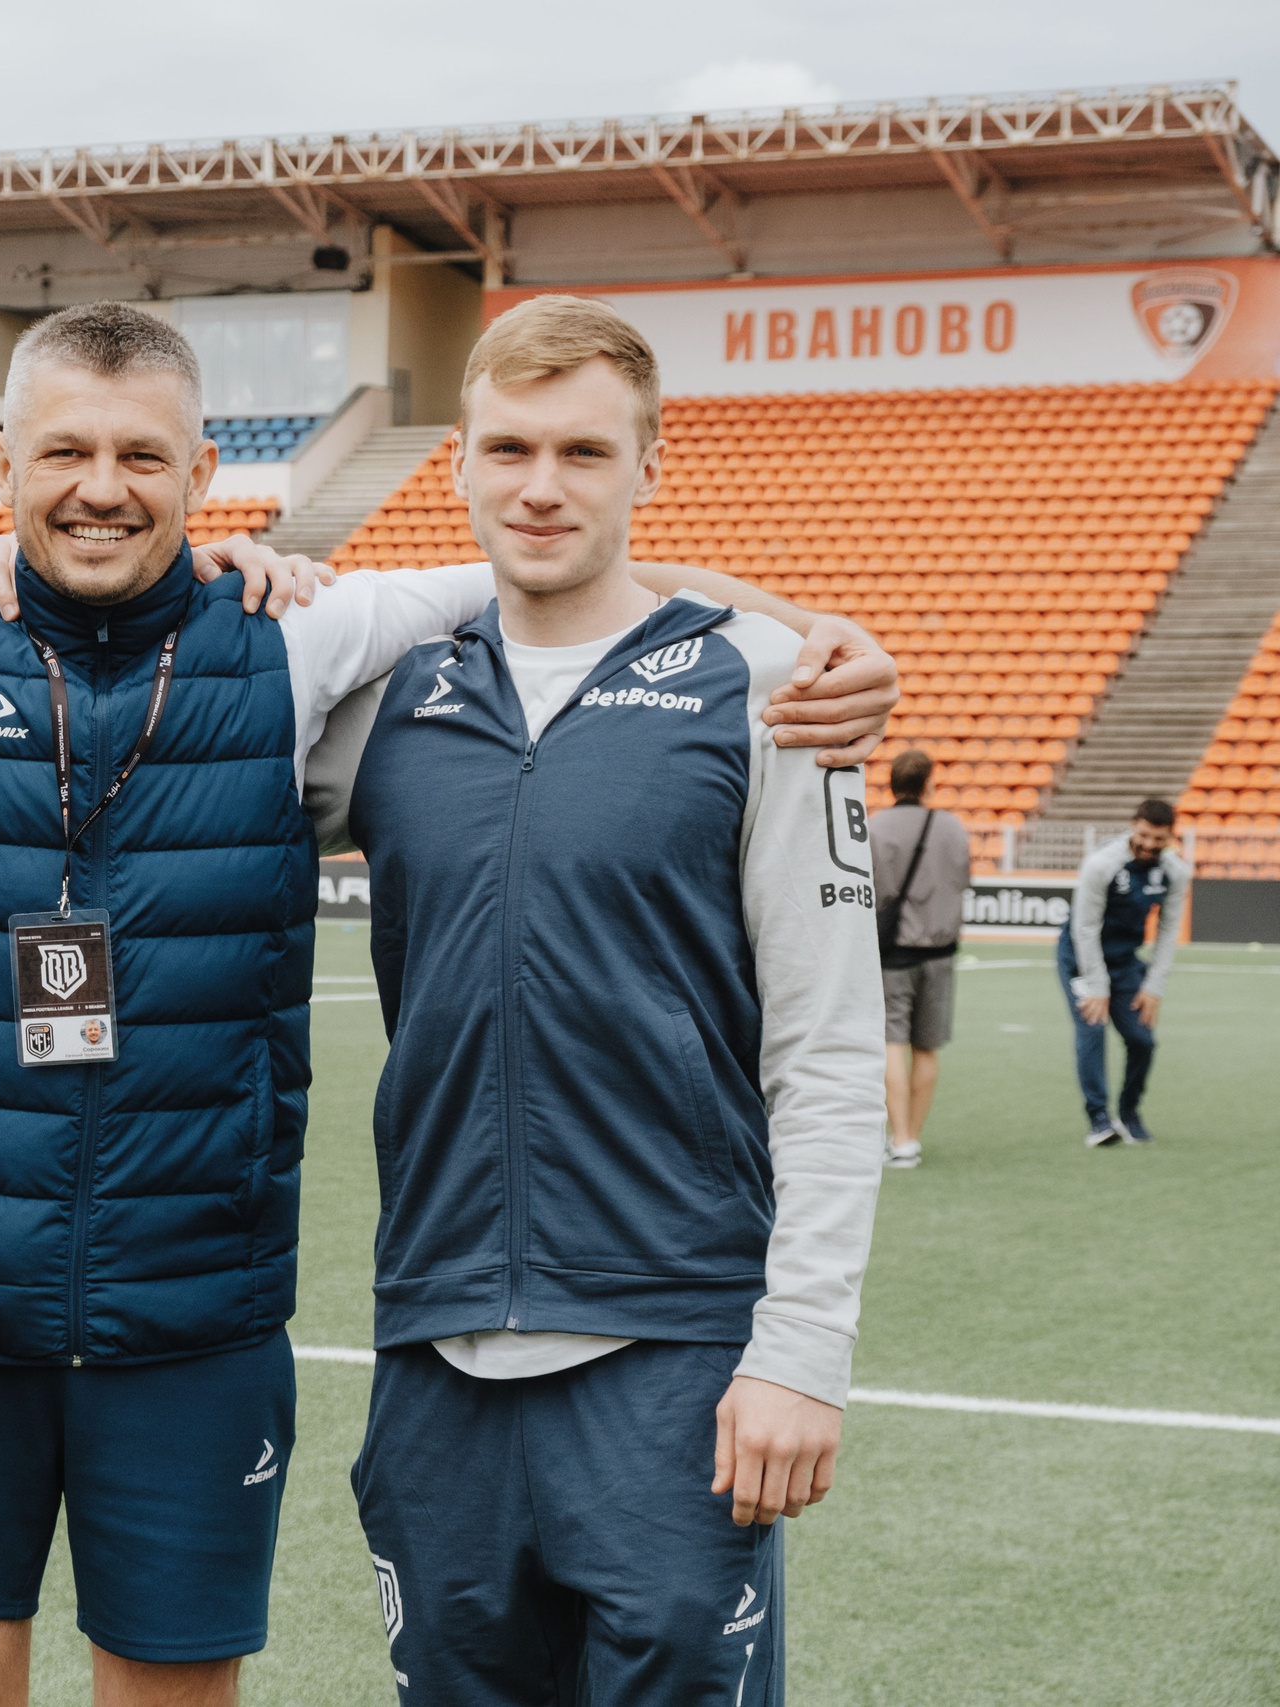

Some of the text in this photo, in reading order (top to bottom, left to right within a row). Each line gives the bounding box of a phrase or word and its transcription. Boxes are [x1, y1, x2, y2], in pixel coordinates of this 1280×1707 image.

[725, 302, 1017, 361] ИВАНОВО
[414, 703, 465, 718] DEMIX
[580, 687, 703, 713] BetBoom
[60, 782, 69, 802] MFL
[107, 782, 121, 799] MFL
[820, 883, 873, 909] BetB
[961, 888, 1071, 924] inline
[243, 1463, 279, 1486] DEMIX
[722, 1606, 766, 1635] DEMIX
